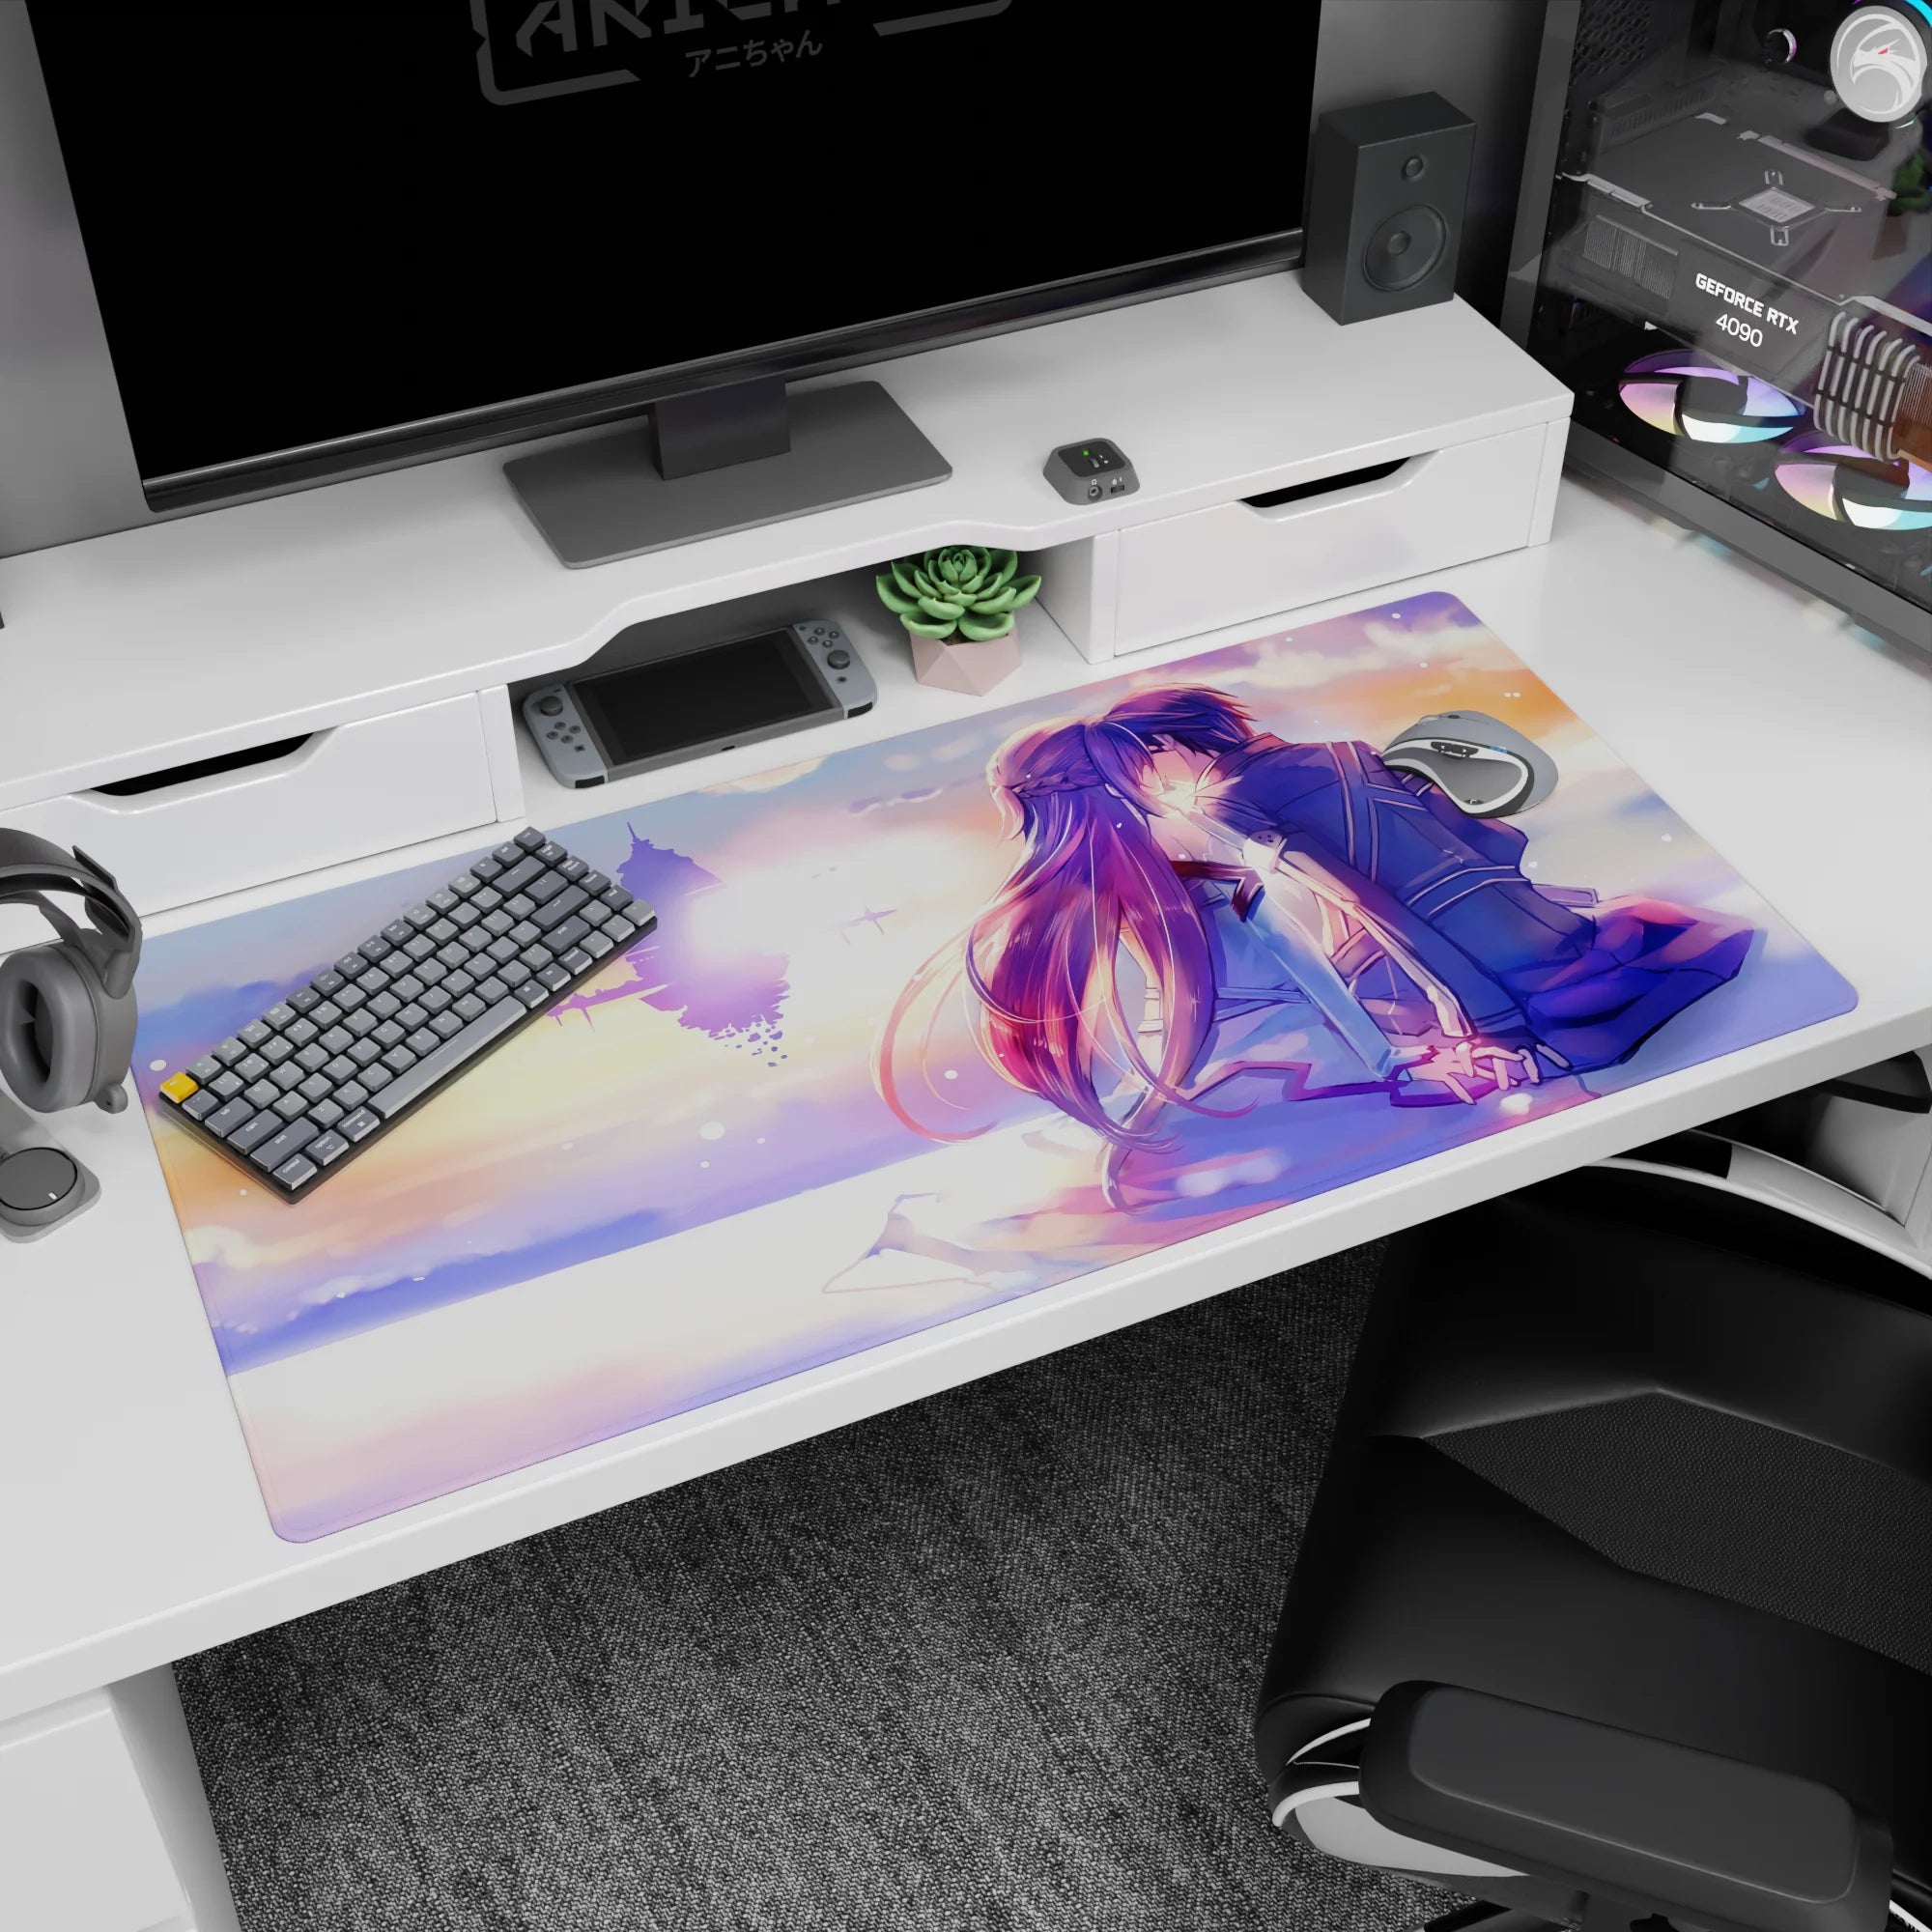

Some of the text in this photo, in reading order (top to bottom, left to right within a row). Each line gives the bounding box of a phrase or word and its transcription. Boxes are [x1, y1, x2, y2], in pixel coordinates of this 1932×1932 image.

[685, 29, 823, 78] アニちゃん
[1695, 272, 1800, 335] GEFORCE RTX
[1716, 313, 1764, 348] 4090
